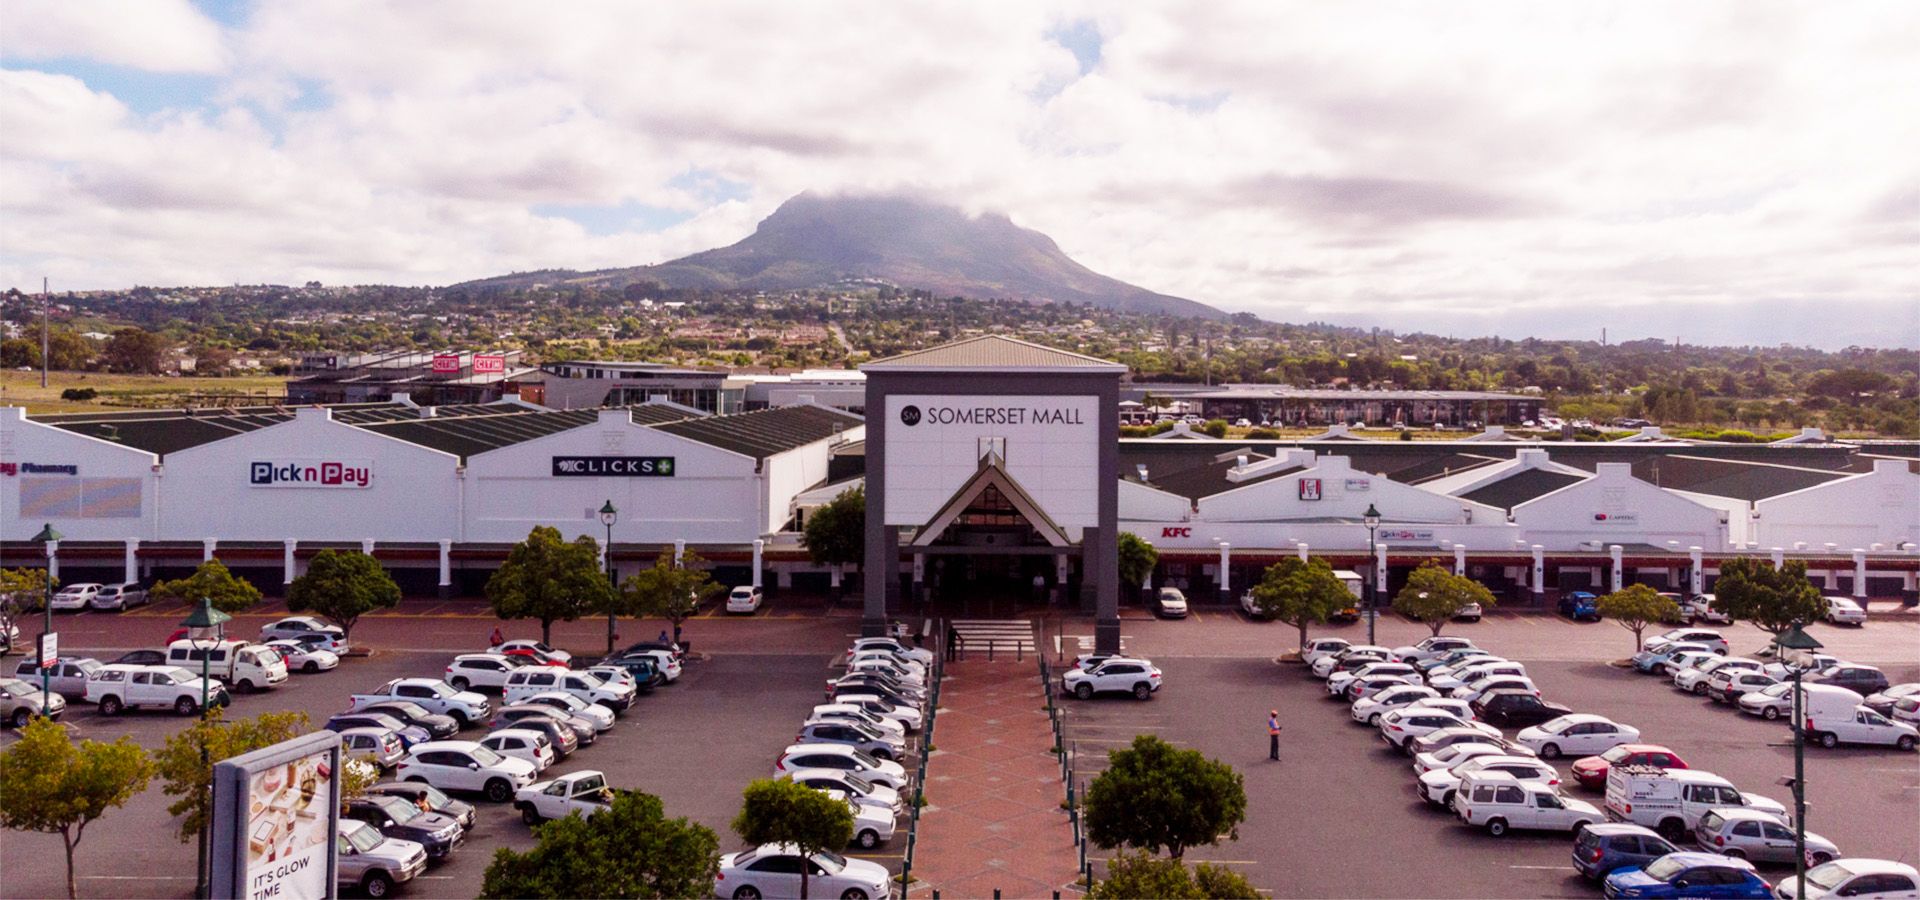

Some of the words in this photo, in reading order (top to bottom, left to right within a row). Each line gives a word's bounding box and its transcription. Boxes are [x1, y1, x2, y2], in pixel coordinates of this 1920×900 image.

[928, 408, 1026, 424] SOMERSET
[1032, 408, 1084, 424] MALL
[22, 463, 77, 475] Pharmacy
[251, 462, 301, 484] Pick
[305, 467, 317, 481] n
[321, 463, 369, 486] Pay
[574, 461, 653, 472] CLICKS
[1161, 527, 1192, 538] KFC
[254, 870, 274, 889] IT'S
[276, 856, 310, 879] GLOW
[254, 882, 280, 900] TIME
